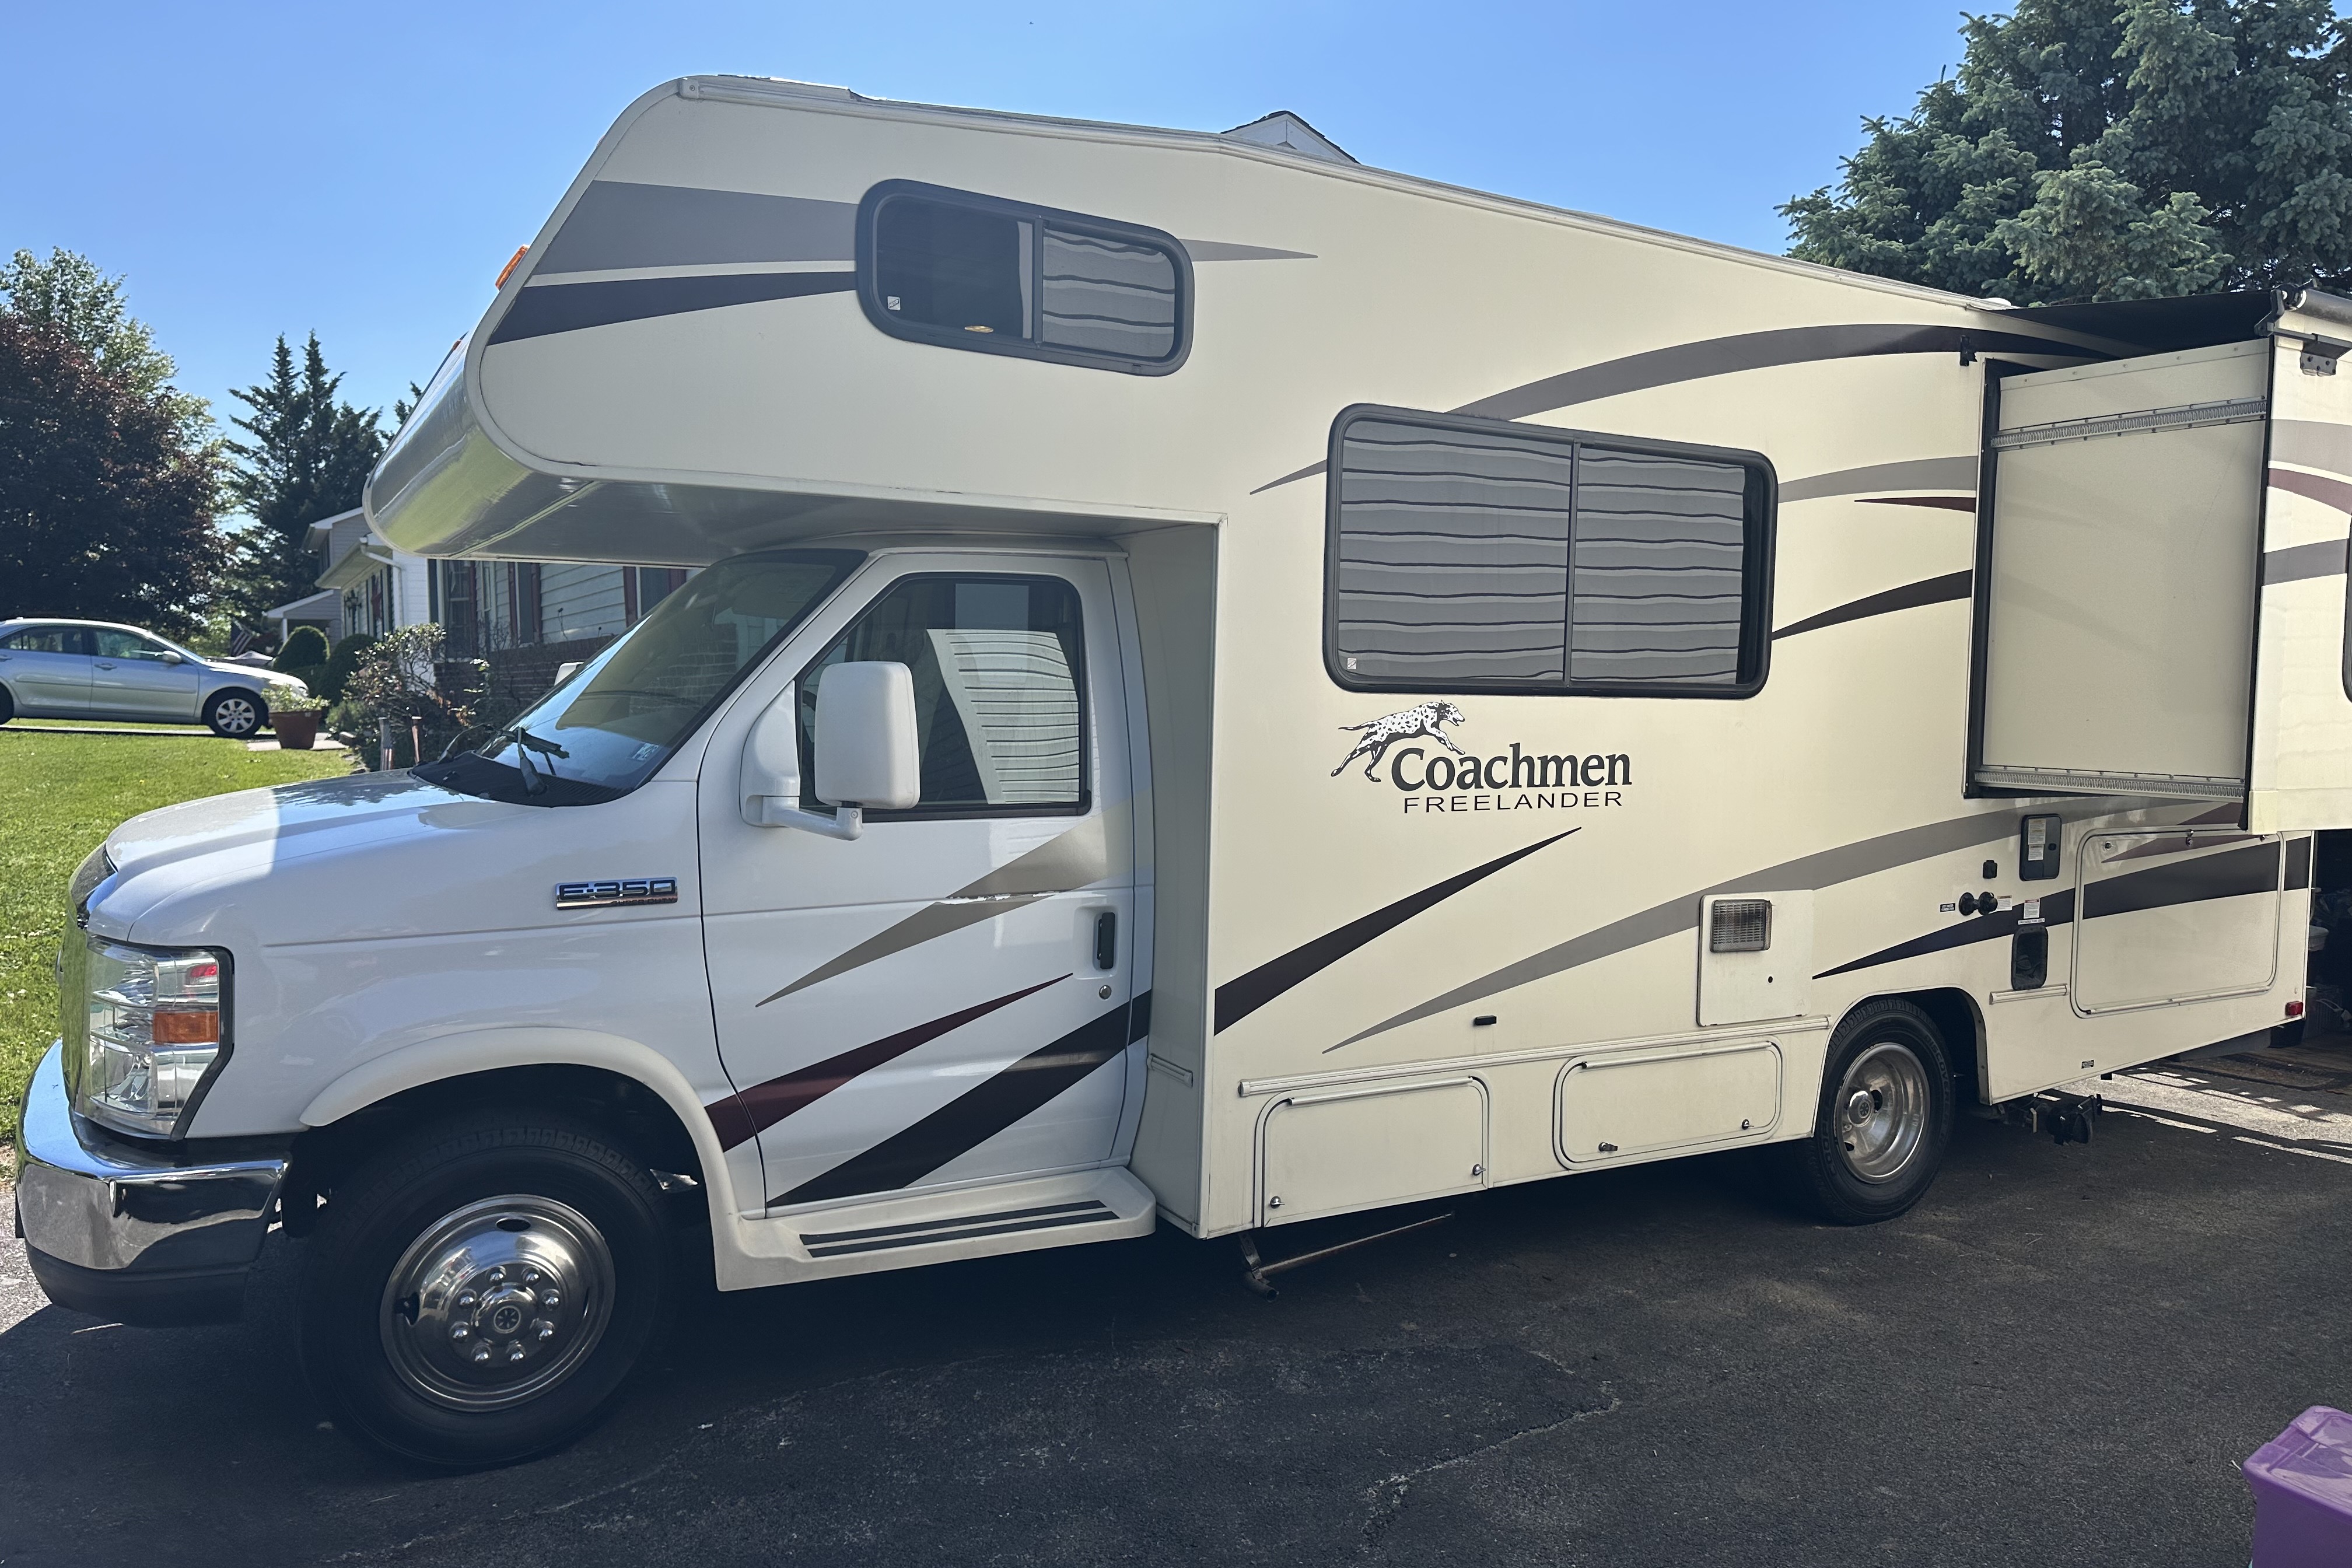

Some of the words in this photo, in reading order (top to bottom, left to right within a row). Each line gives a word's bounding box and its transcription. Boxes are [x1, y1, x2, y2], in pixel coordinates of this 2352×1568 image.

[1391, 743, 1632, 791] Coachmen
[1404, 792, 1622, 814] FREELANDER
[559, 880, 676, 900] E-350
